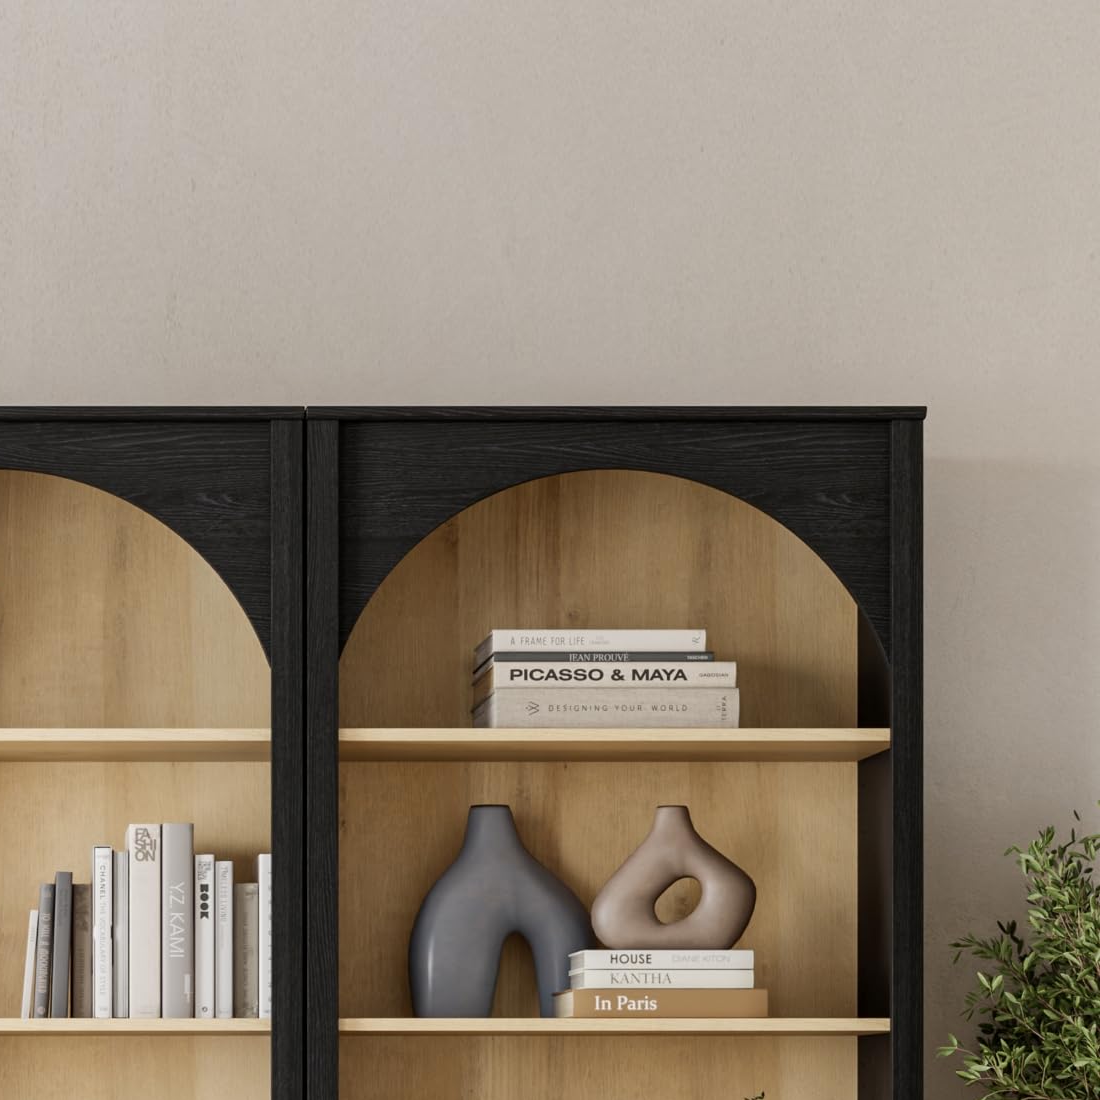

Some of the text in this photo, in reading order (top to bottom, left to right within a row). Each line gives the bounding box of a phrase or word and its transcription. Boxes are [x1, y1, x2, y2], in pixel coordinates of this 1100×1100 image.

[510, 636, 517, 645] A
[520, 636, 548, 645] FRAME
[551, 636, 567, 645] FOR
[569, 636, 585, 645] LIFE
[569, 652, 591, 662] JEAN
[509, 668, 688, 681] PICASSO & MAYA
[548, 704, 688, 712] DESIGNING YOUR WORLD
[200, 884, 209, 920] BOOK
[169, 912, 185, 958] KAMI
[610, 953, 652, 964] HOUSE
[609, 972, 672, 985] KANTHA
[594, 995, 658, 1011] In Paris
